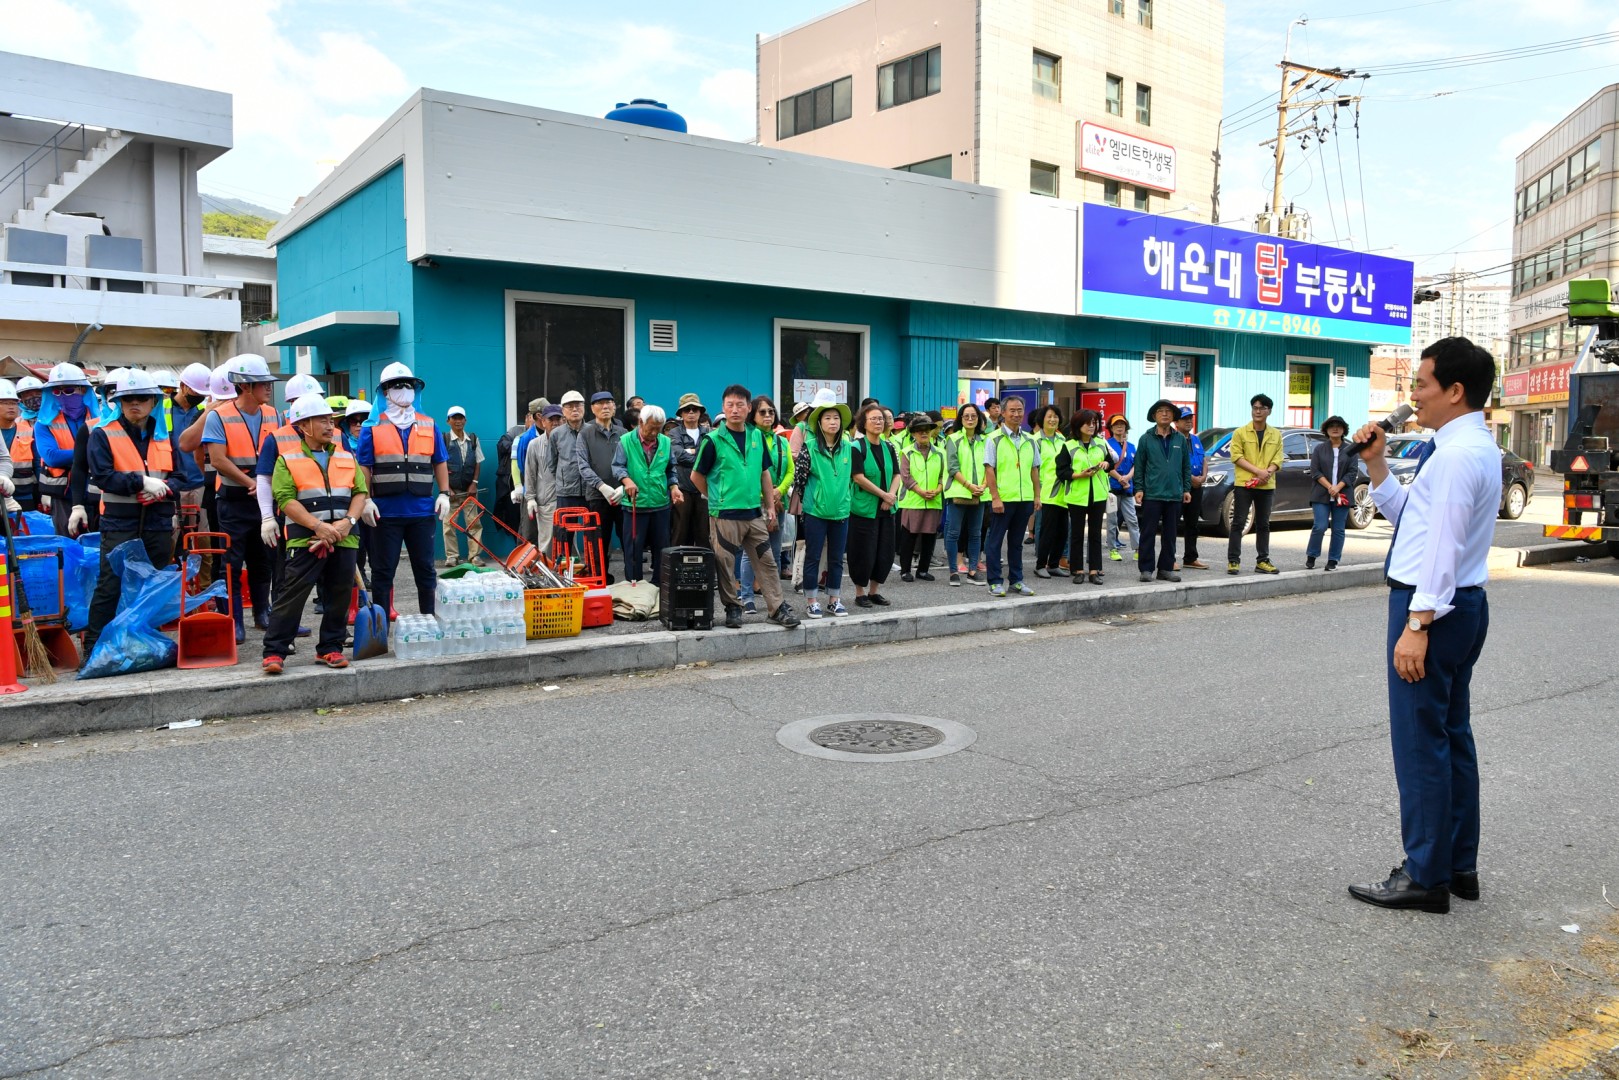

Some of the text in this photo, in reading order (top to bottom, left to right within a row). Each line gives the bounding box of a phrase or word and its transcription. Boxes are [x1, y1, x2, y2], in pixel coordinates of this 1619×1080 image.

[1109, 138, 1172, 174] 엘리트학생복
[1143, 235, 1376, 316] 해운대 탑 부동산
[1237, 309, 1322, 336] 747-8946
